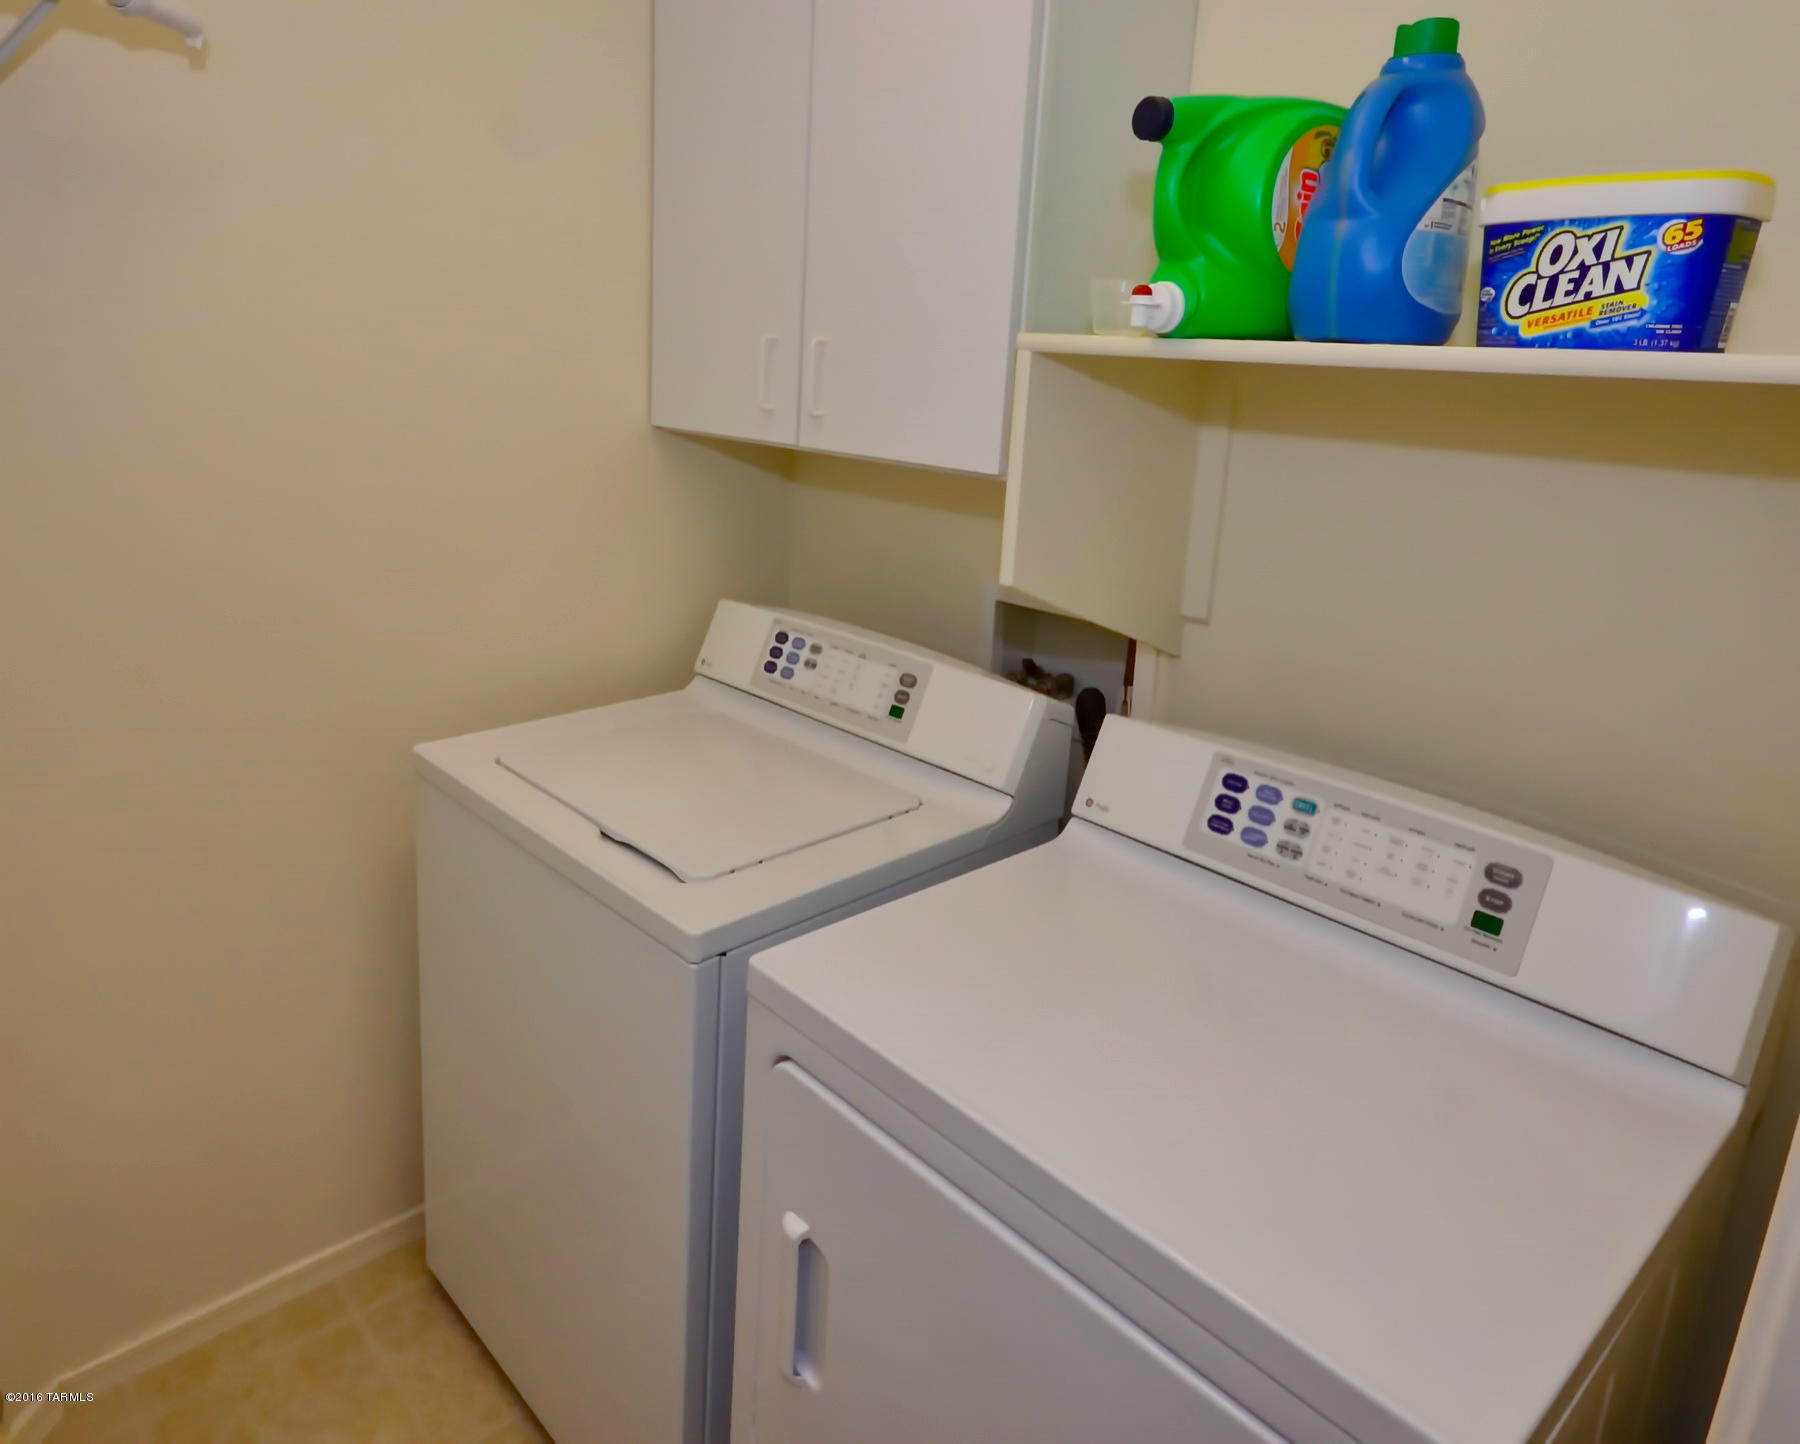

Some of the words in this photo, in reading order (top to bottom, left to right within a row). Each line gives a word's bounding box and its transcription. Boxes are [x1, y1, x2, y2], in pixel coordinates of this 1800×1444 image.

[1663, 218, 1704, 246] 65
[1536, 225, 1624, 277] OXI
[1666, 238, 1700, 253] LOADS
[1505, 251, 1652, 319] CLEAN
[1598, 303, 1638, 317] REMOVER
[1601, 299, 1624, 310] STAIN
[1526, 305, 1594, 330] VERSATILE
